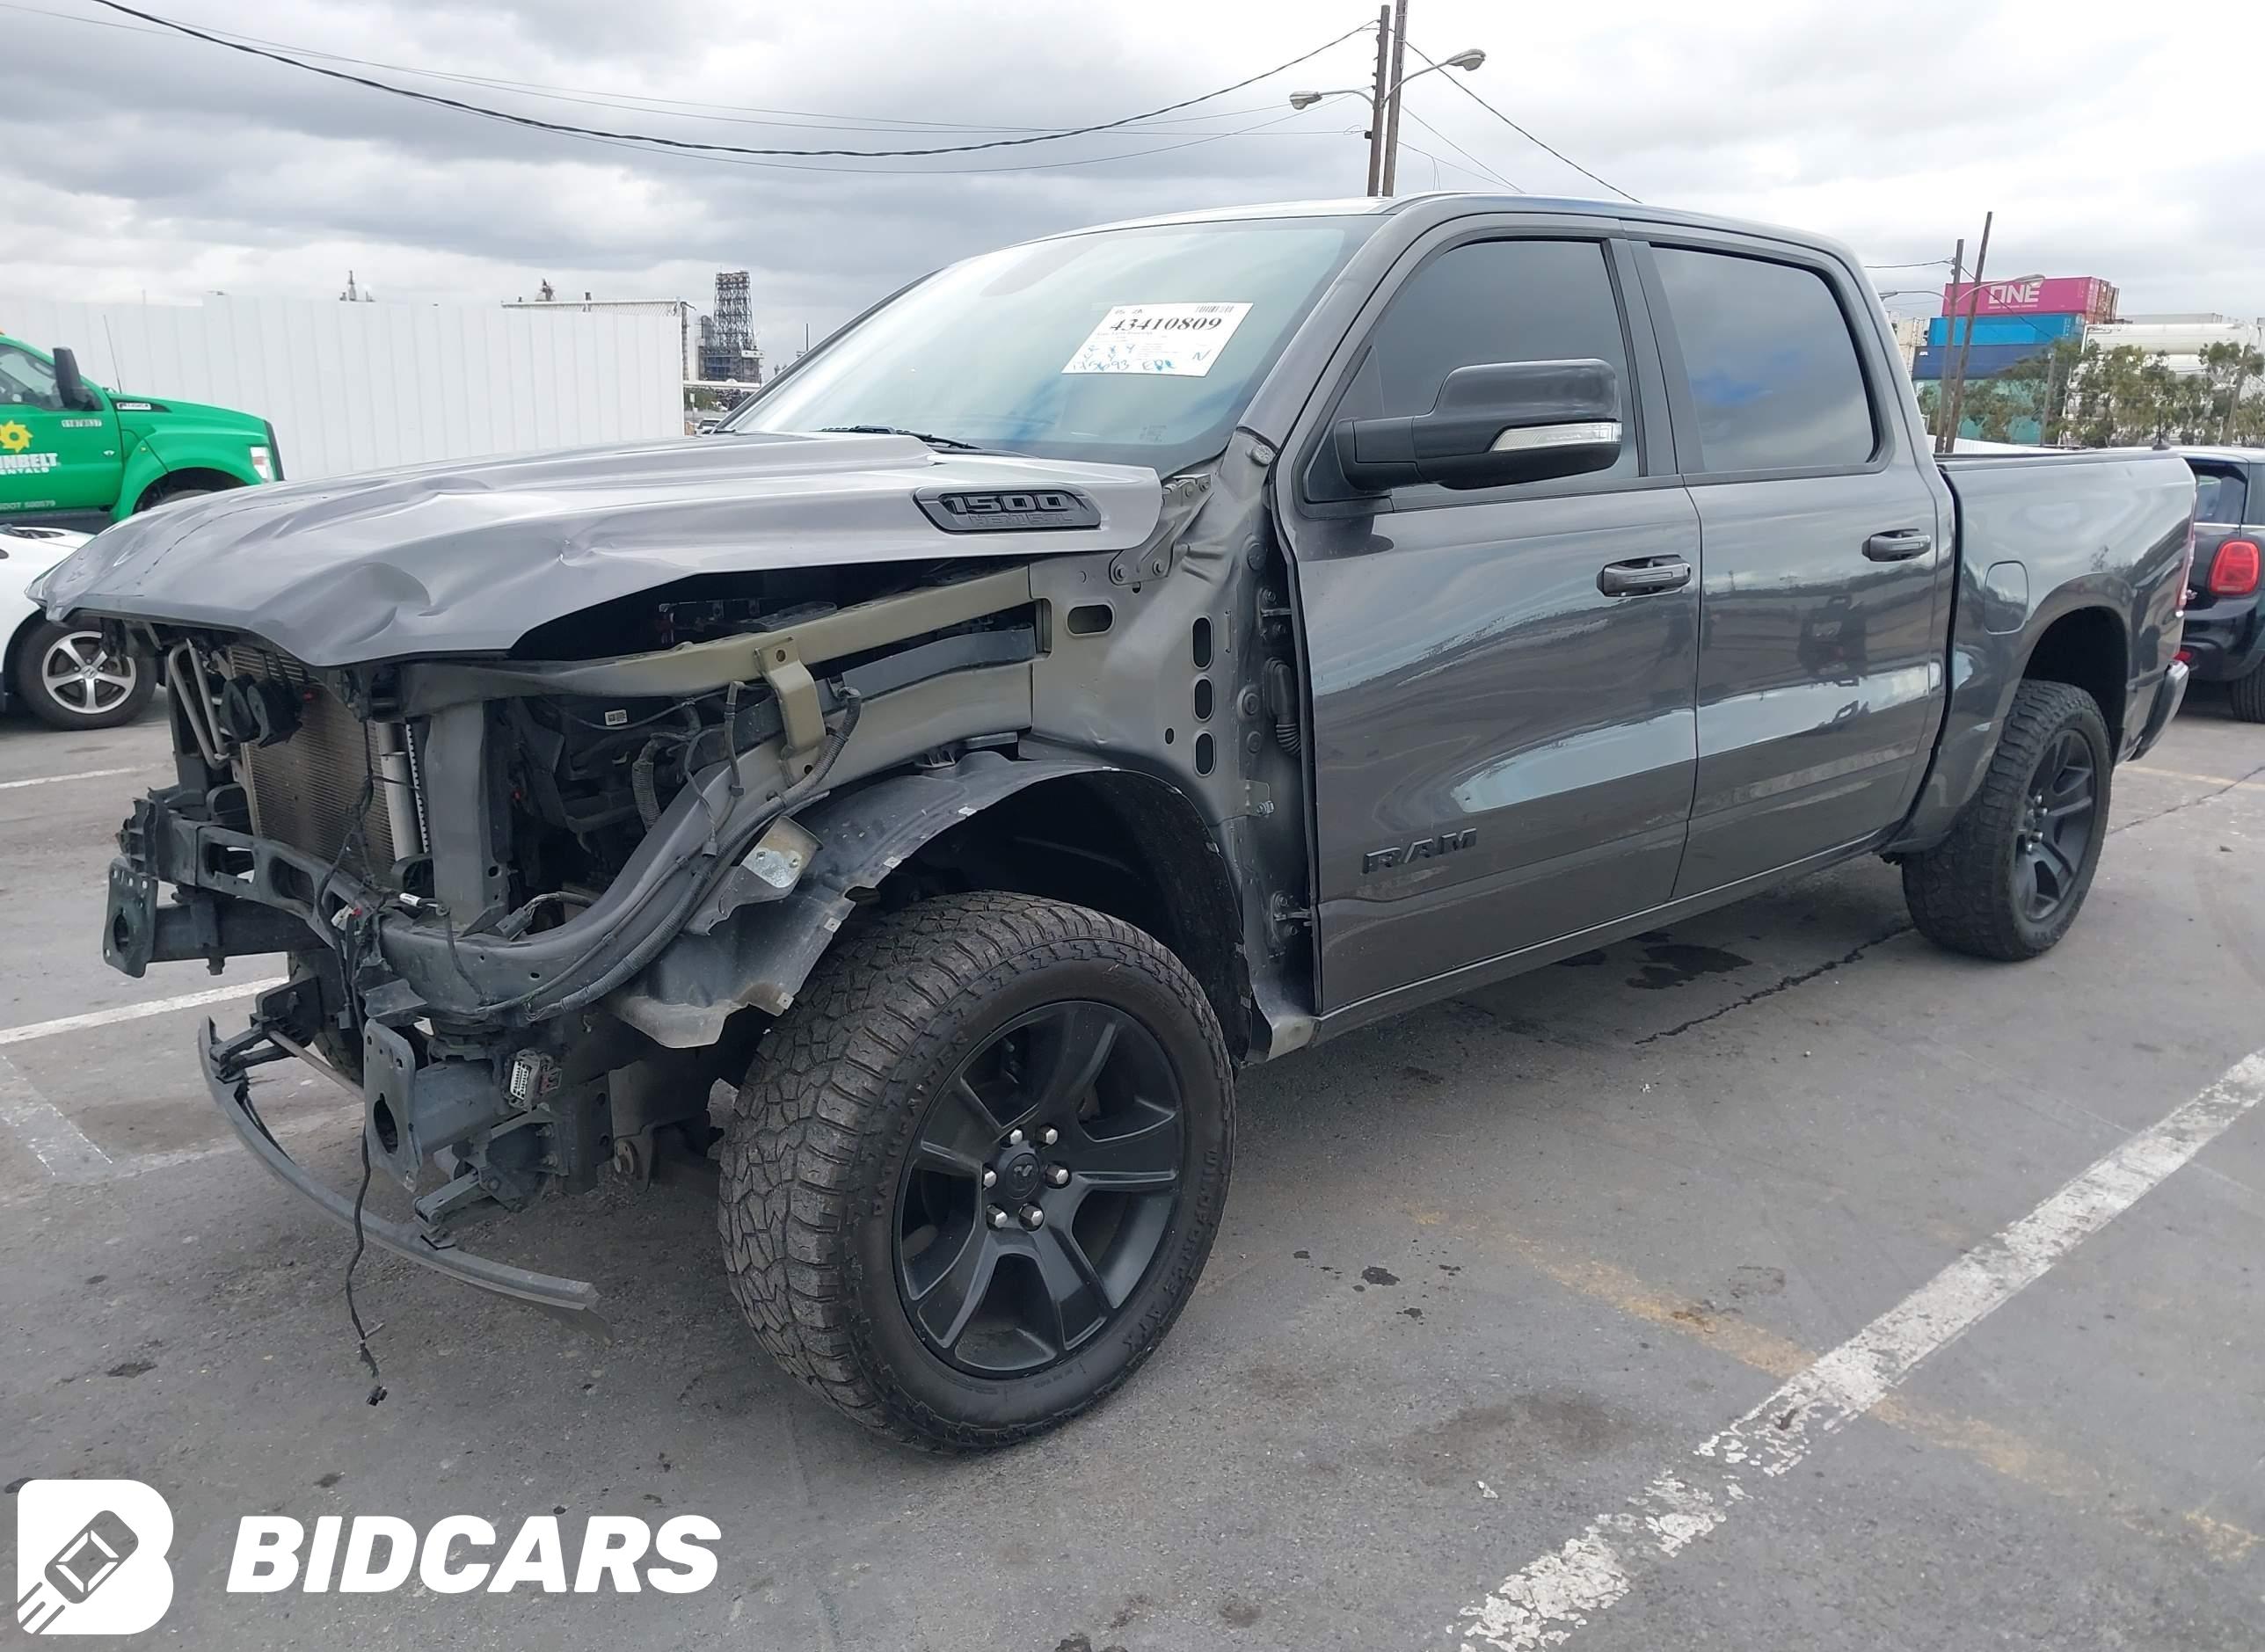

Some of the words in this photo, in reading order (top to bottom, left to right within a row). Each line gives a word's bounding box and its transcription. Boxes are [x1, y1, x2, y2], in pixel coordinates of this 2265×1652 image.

[1988, 284, 2041, 304] ONE
[1110, 317, 1223, 331] 43410809
[943, 493, 1069, 513] 1500
[1363, 827, 1477, 874] RAM
